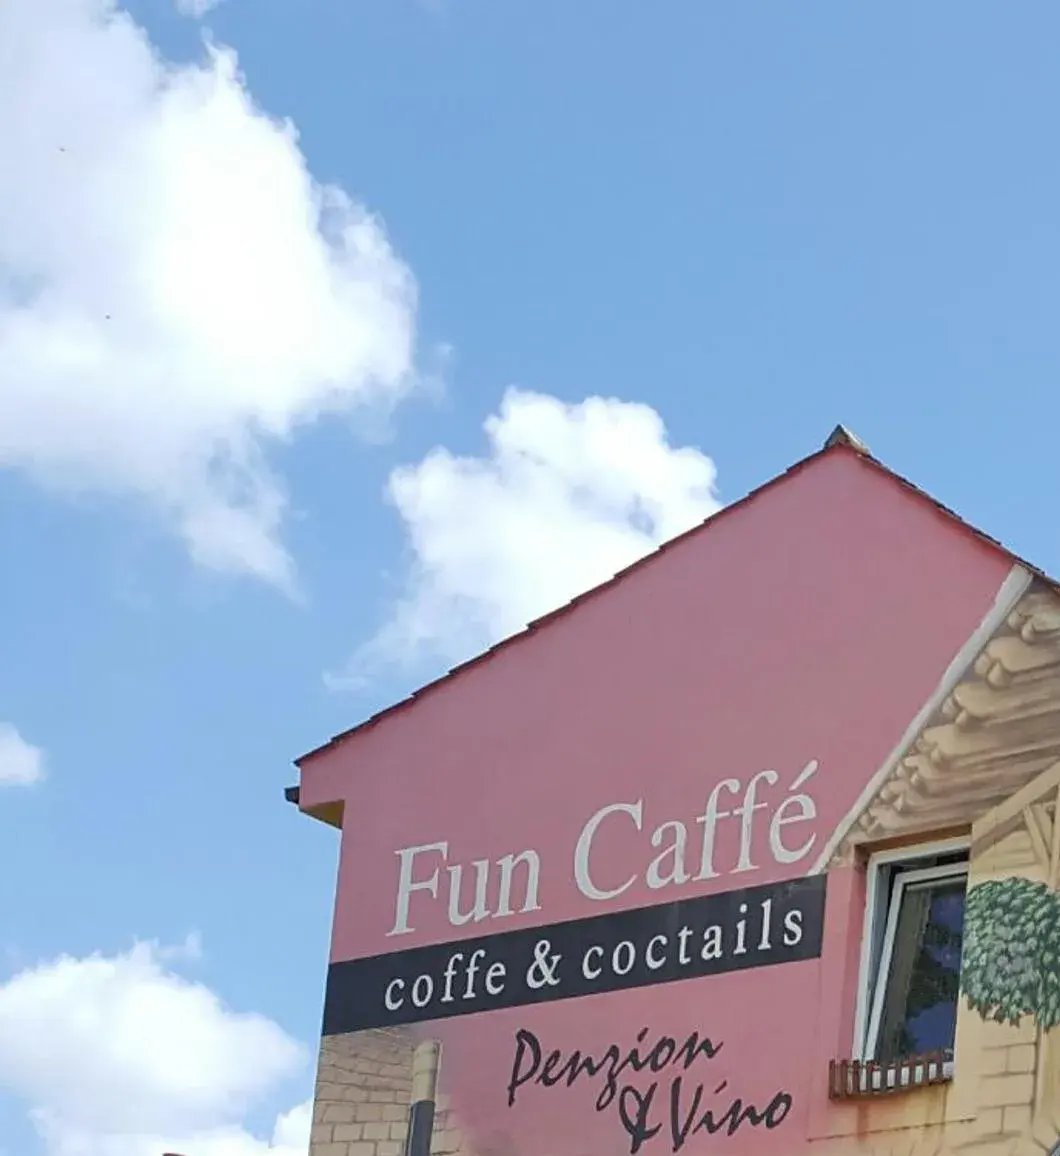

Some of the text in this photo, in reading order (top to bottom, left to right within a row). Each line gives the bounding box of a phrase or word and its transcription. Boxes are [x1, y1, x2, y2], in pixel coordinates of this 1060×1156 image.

[385, 759, 819, 936] Fun Caffé
[384, 900, 803, 1011] coffe & coctails
[618, 1081, 662, 1155] &
